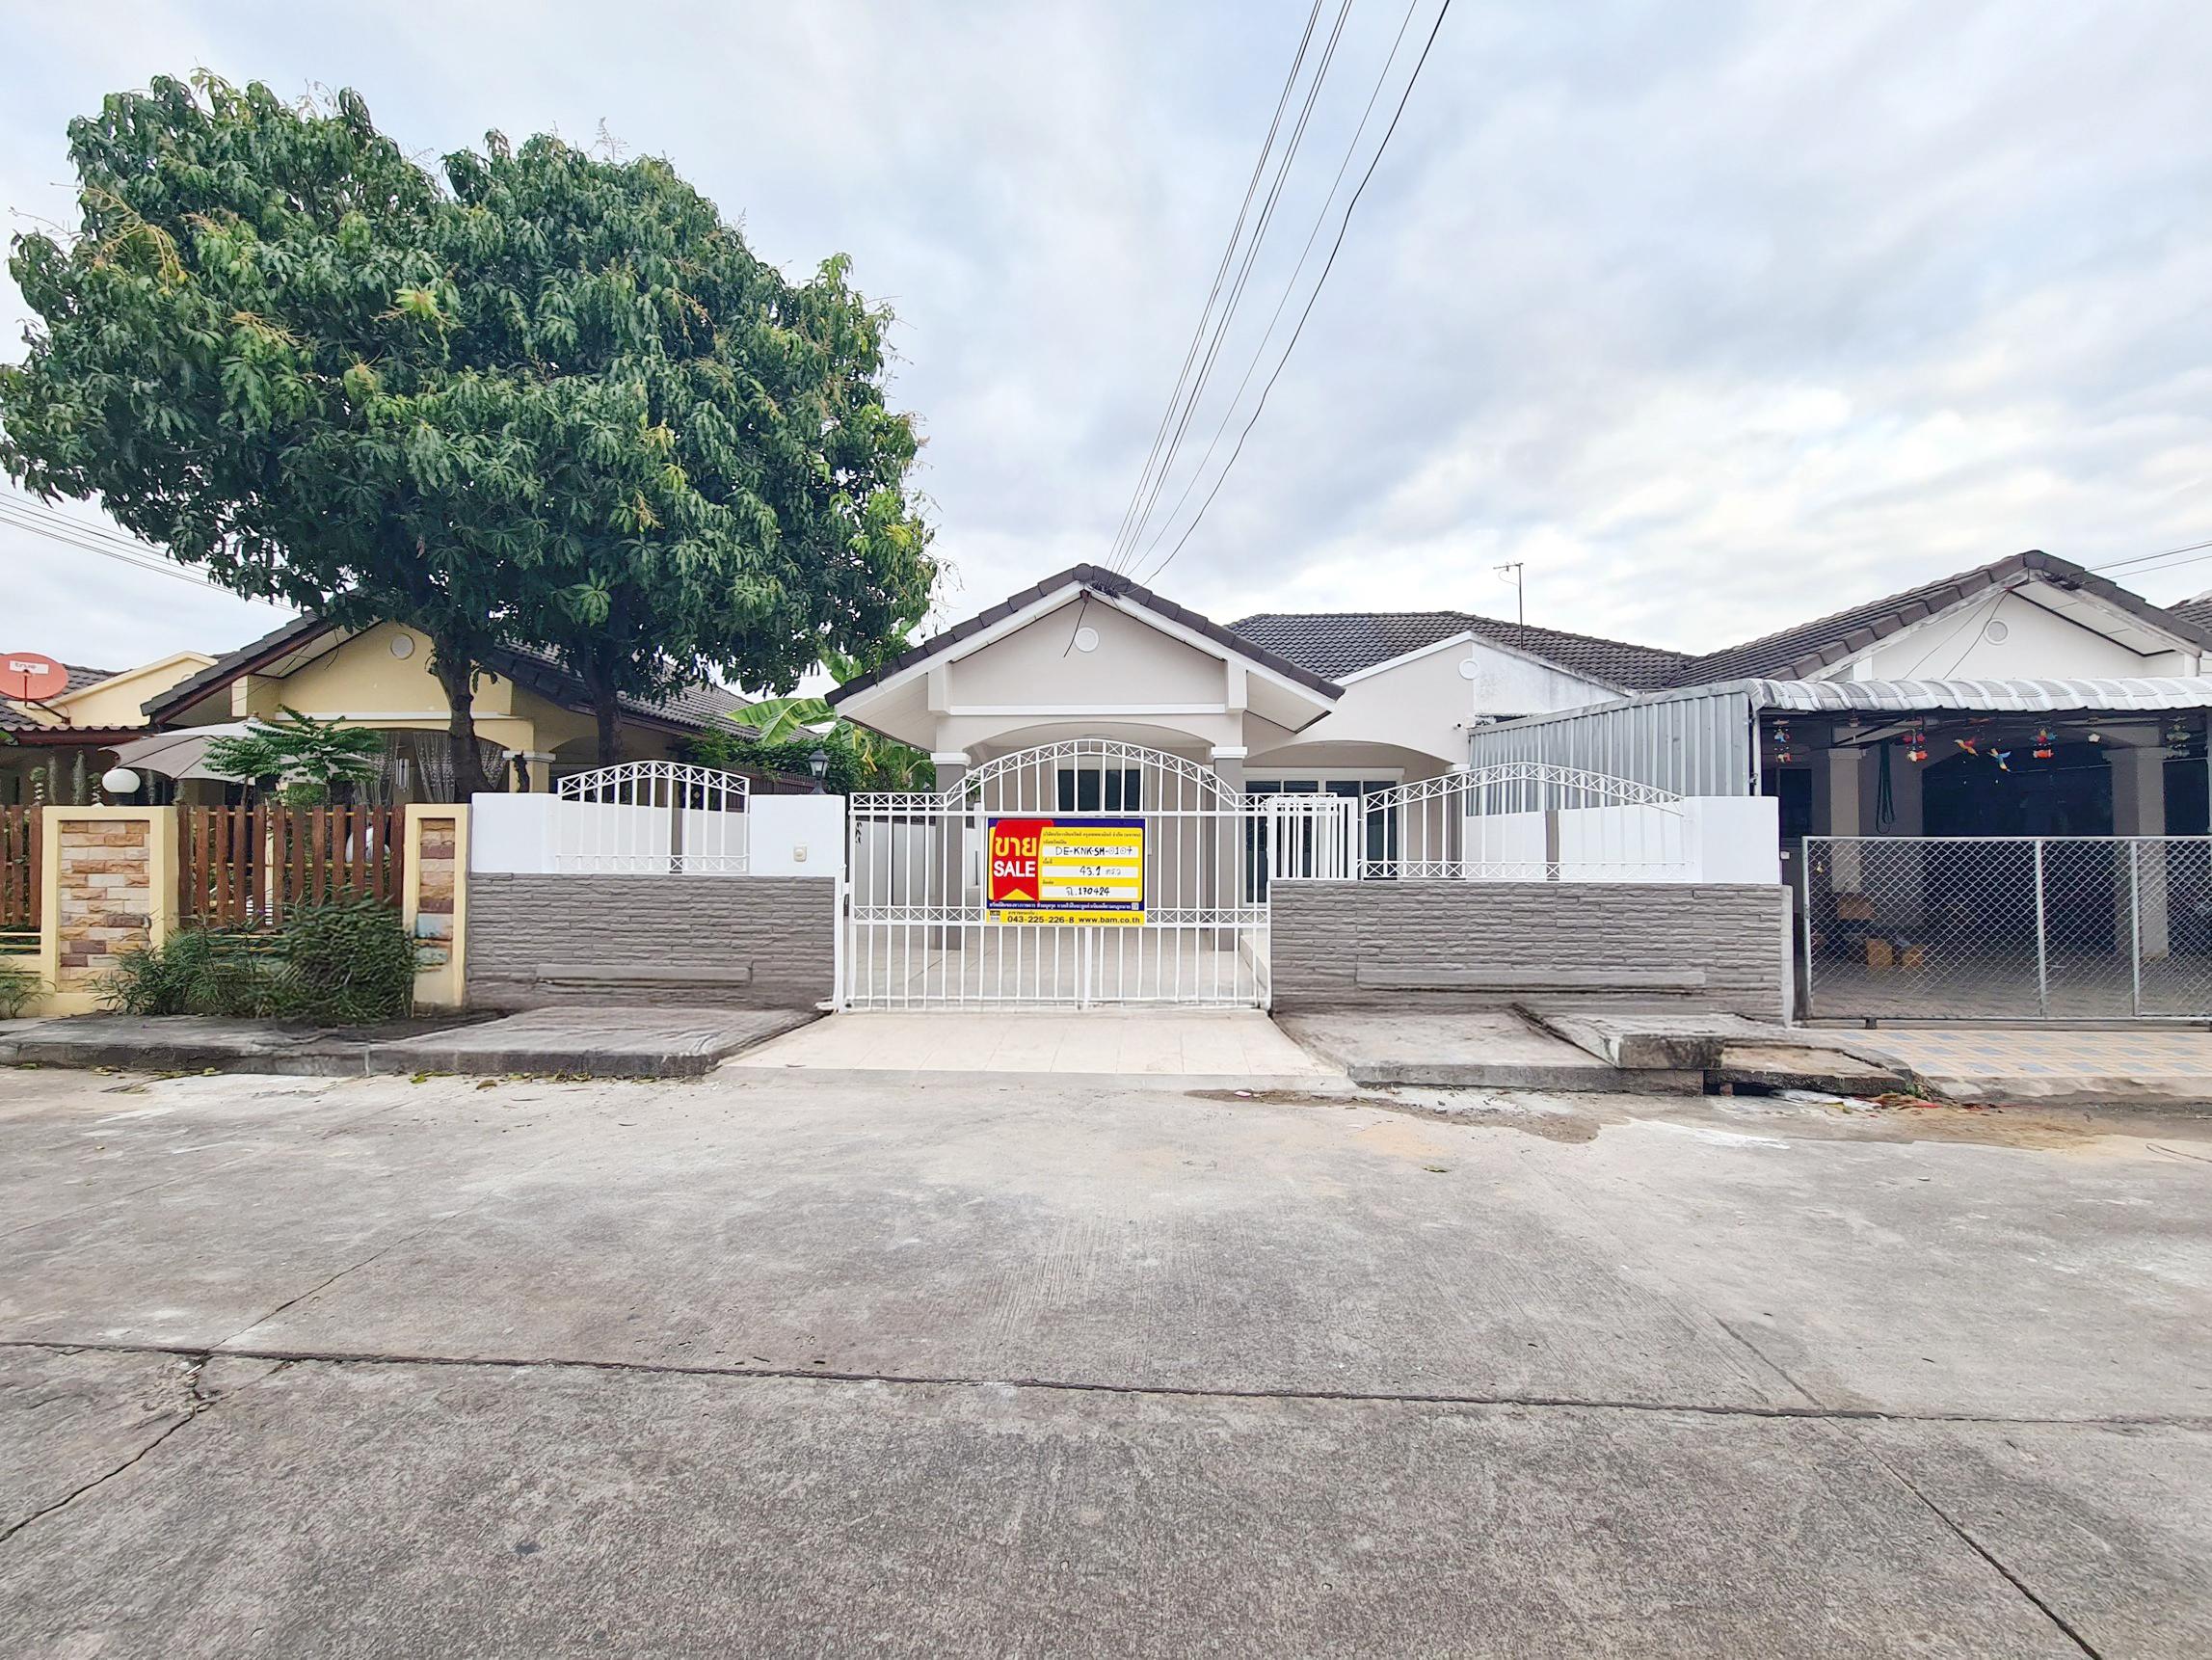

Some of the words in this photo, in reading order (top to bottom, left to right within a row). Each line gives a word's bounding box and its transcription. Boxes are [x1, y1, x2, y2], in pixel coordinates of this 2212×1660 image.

[996, 837, 1036, 856] ขาย
[994, 861, 1035, 877] SALE
[1079, 866, 1101, 876] 43.1
